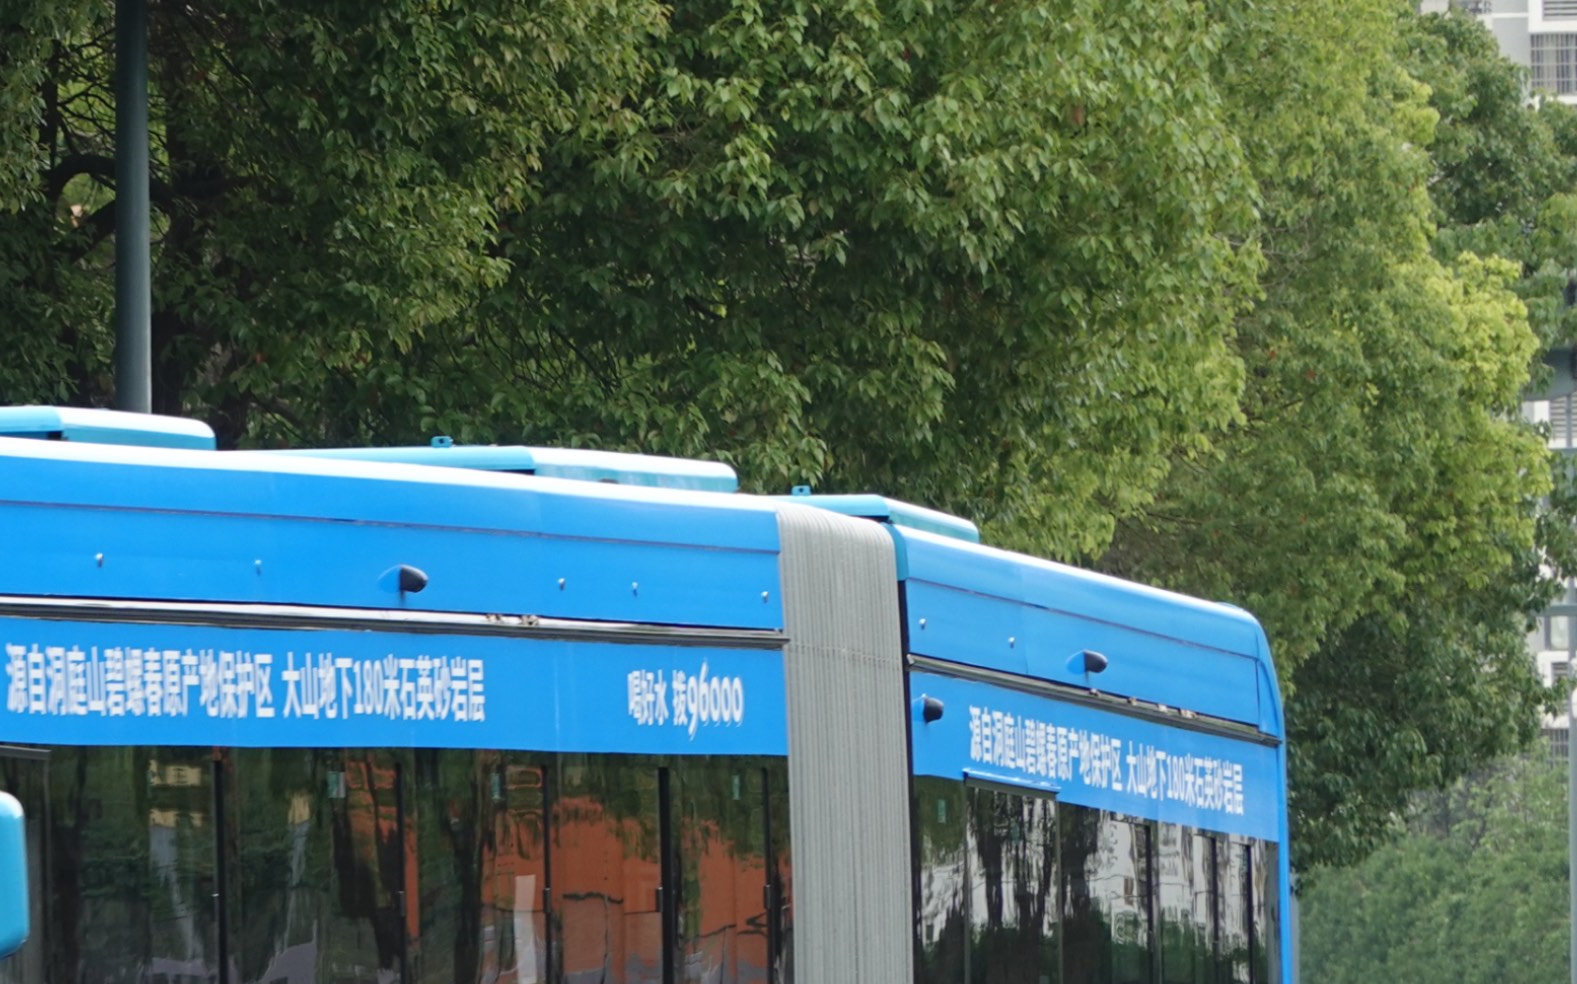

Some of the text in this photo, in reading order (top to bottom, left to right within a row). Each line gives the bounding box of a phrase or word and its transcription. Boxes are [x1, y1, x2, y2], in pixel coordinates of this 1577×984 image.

[6, 643, 486, 721] 源自洞庭山碧螺春原产地保护区 大山地下180米石英砂岩层
[969, 705, 1244, 816] 源自洞庭山碧螺春原产地保护区 大山地下180米石英砂岩层
